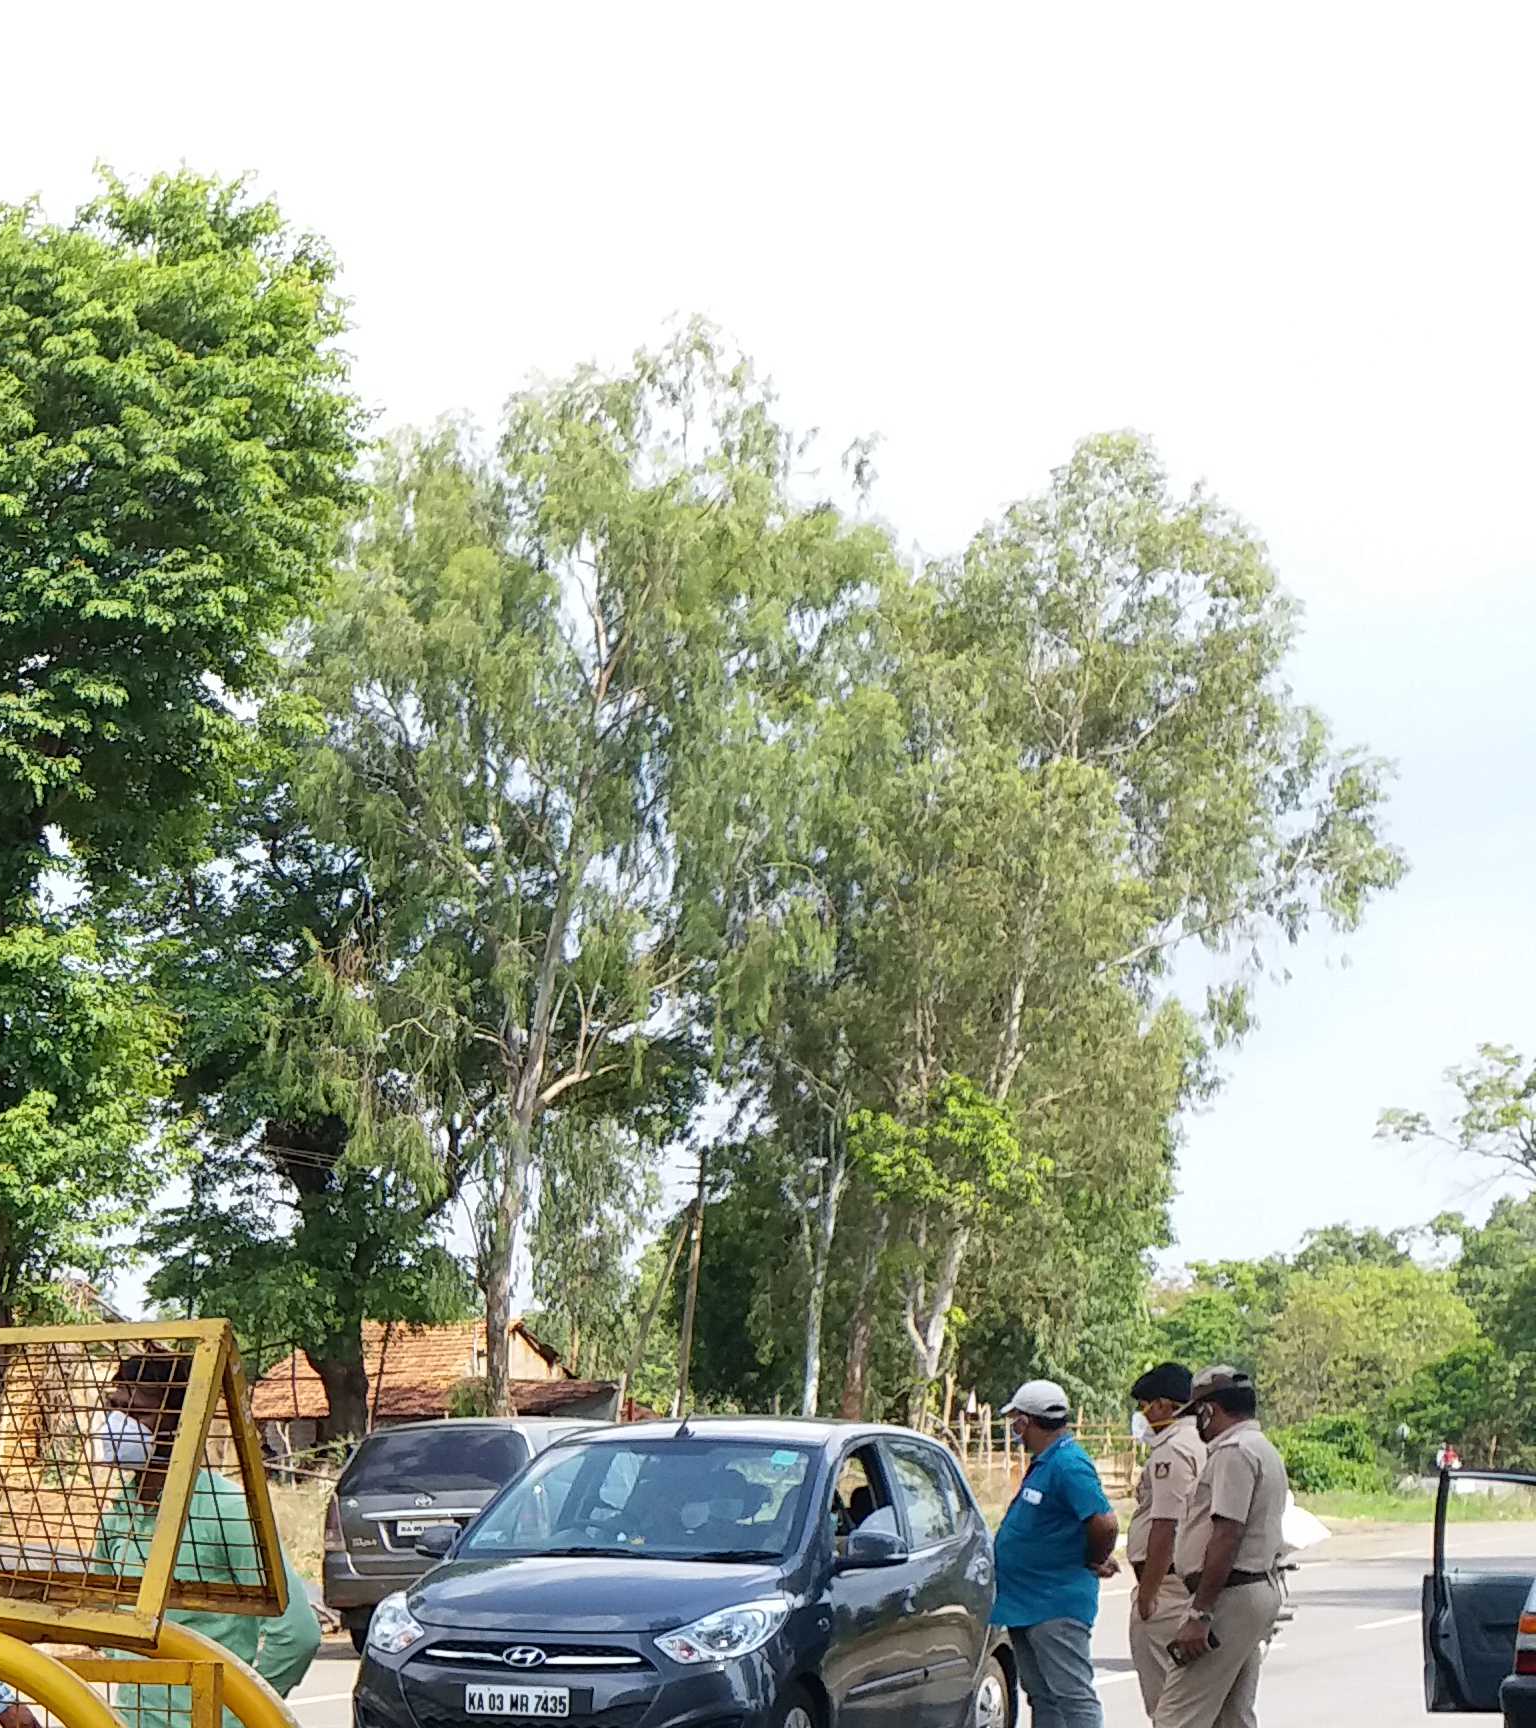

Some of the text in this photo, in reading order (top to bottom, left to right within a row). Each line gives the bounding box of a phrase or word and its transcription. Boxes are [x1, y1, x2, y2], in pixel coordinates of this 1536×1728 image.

[468, 1692, 484, 1712] KA
[488, 1693, 504, 1712] 03
[534, 1694, 567, 1714] 7435
